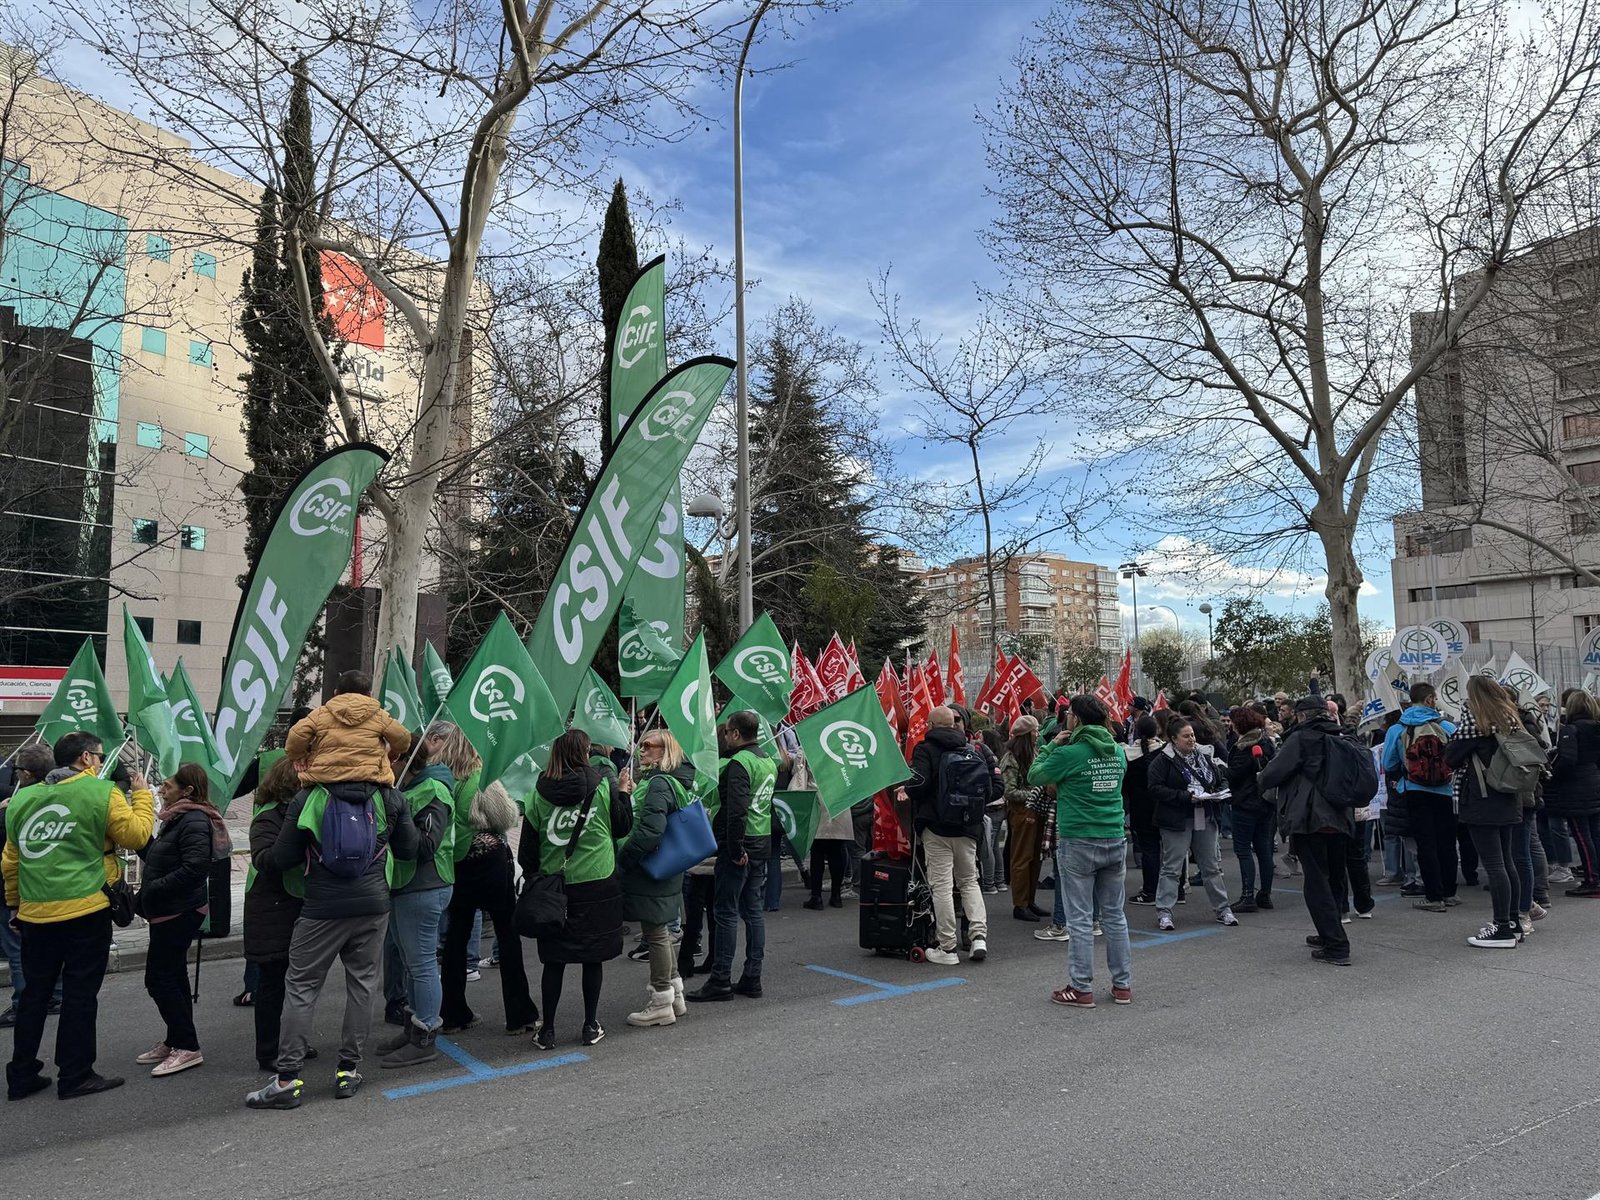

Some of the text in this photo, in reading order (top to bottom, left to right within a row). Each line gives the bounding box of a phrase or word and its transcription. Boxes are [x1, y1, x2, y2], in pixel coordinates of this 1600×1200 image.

[303, 493, 352, 523] CSIF
[553, 472, 633, 665] CSIF
[748, 654, 787, 685] CSIF
[1398, 652, 1442, 663] ANPE
[214, 575, 290, 777] CSIF
[479, 678, 519, 722] CSIF
[837, 730, 869, 770] CSIF
[29, 821, 77, 841] CSIF
[557, 806, 598, 830] CSF
